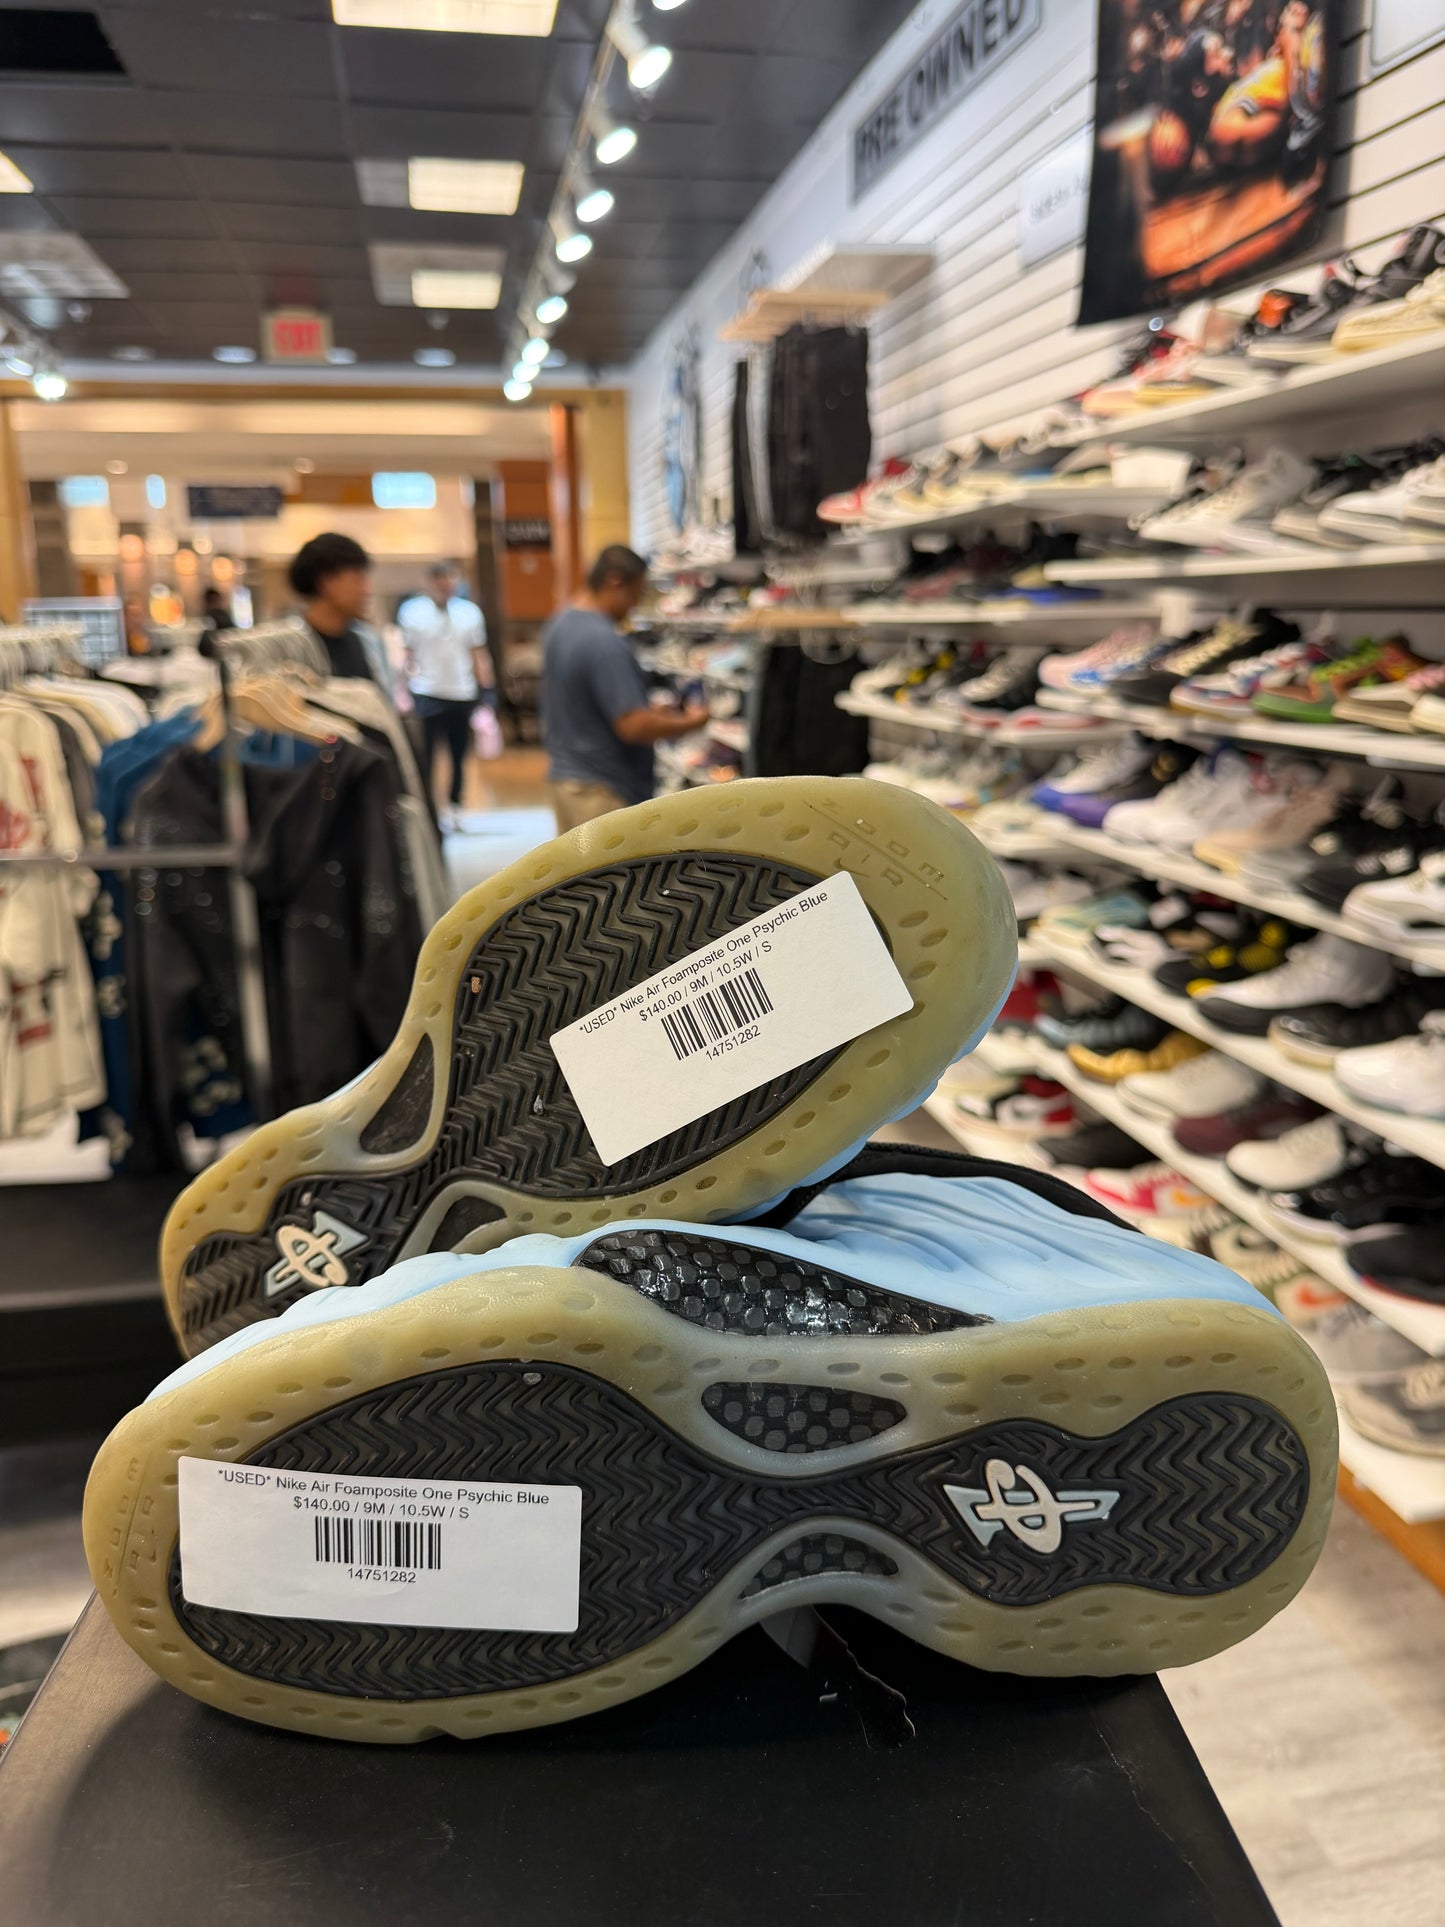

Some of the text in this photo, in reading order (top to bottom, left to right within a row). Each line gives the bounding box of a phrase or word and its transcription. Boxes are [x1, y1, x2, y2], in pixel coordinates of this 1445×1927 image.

[857, 95, 901, 172] PRE
[620, 994, 645, 1013] Nike
[646, 983, 661, 999] Air
[661, 949, 725, 989] Foamposite
[726, 934, 751, 952] One
[752, 908, 799, 938] Psychic
[799, 892, 828, 912] Blue
[639, 990, 682, 1022] $140.00
[689, 975, 709, 993] 9M
[716, 950, 753, 978] 10.5W
[763, 941, 772, 953] S
[705, 1024, 761, 1061] 14751282
[276, 1476, 307, 1491] Nike
[311, 1480, 331, 1493] Air
[335, 1481, 418, 1499] Foamposite
[422, 1487, 453, 1500] One
[457, 1488, 513, 1505] Psychic
[517, 1491, 550, 1505] Blue
[293, 1496, 350, 1512] $140.00
[363, 1502, 386, 1515] 9M
[400, 1504, 446, 1517] 10.5W
[459, 1507, 470, 1519] S
[347, 1568, 417, 1584] 14751282
